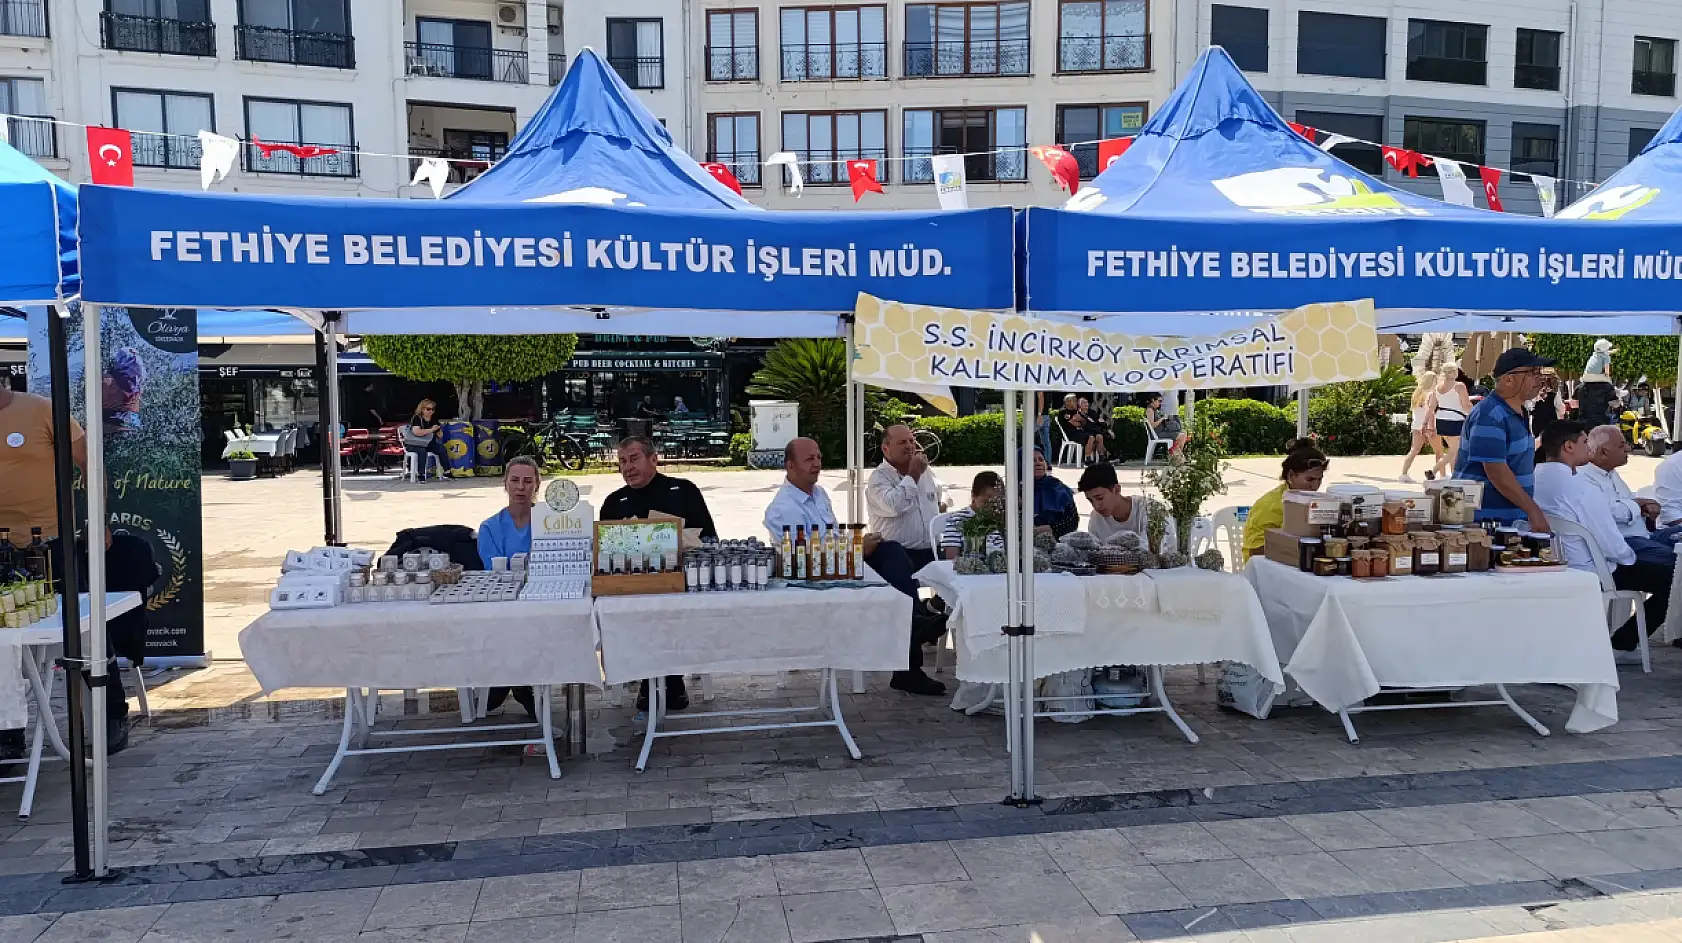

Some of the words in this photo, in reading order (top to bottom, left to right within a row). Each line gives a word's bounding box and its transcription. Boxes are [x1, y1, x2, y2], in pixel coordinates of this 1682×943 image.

[151, 226, 329, 264] FETHİYE
[344, 230, 572, 268] BELEDİYESİ
[587, 234, 735, 273] KÜLTÜR
[747, 238, 857, 281] İŞLERİ
[870, 243, 952, 277] MÜD.
[1087, 245, 1220, 277] FETHİYE
[1231, 246, 1405, 279] BELEDİYESİ
[1414, 247, 1530, 278] KÜLTÜR
[1538, 247, 1625, 284] İŞLERİ
[924, 323, 974, 347] S.S.
[988, 323, 1123, 364] İNCİRKÖY
[1133, 323, 1286, 364] TARIMSAL
[10, 365, 27, 376] ŞE
[219, 366, 239, 377] ŞEF
[572, 359, 590, 368] PUB
[614, 359, 652, 368] COCKTAIL
[931, 355, 1093, 386] KALKINMA
[1103, 345, 1294, 386] KOOPERATİFİ
[113, 470, 134, 499] of
[136, 473, 191, 489] Nature
